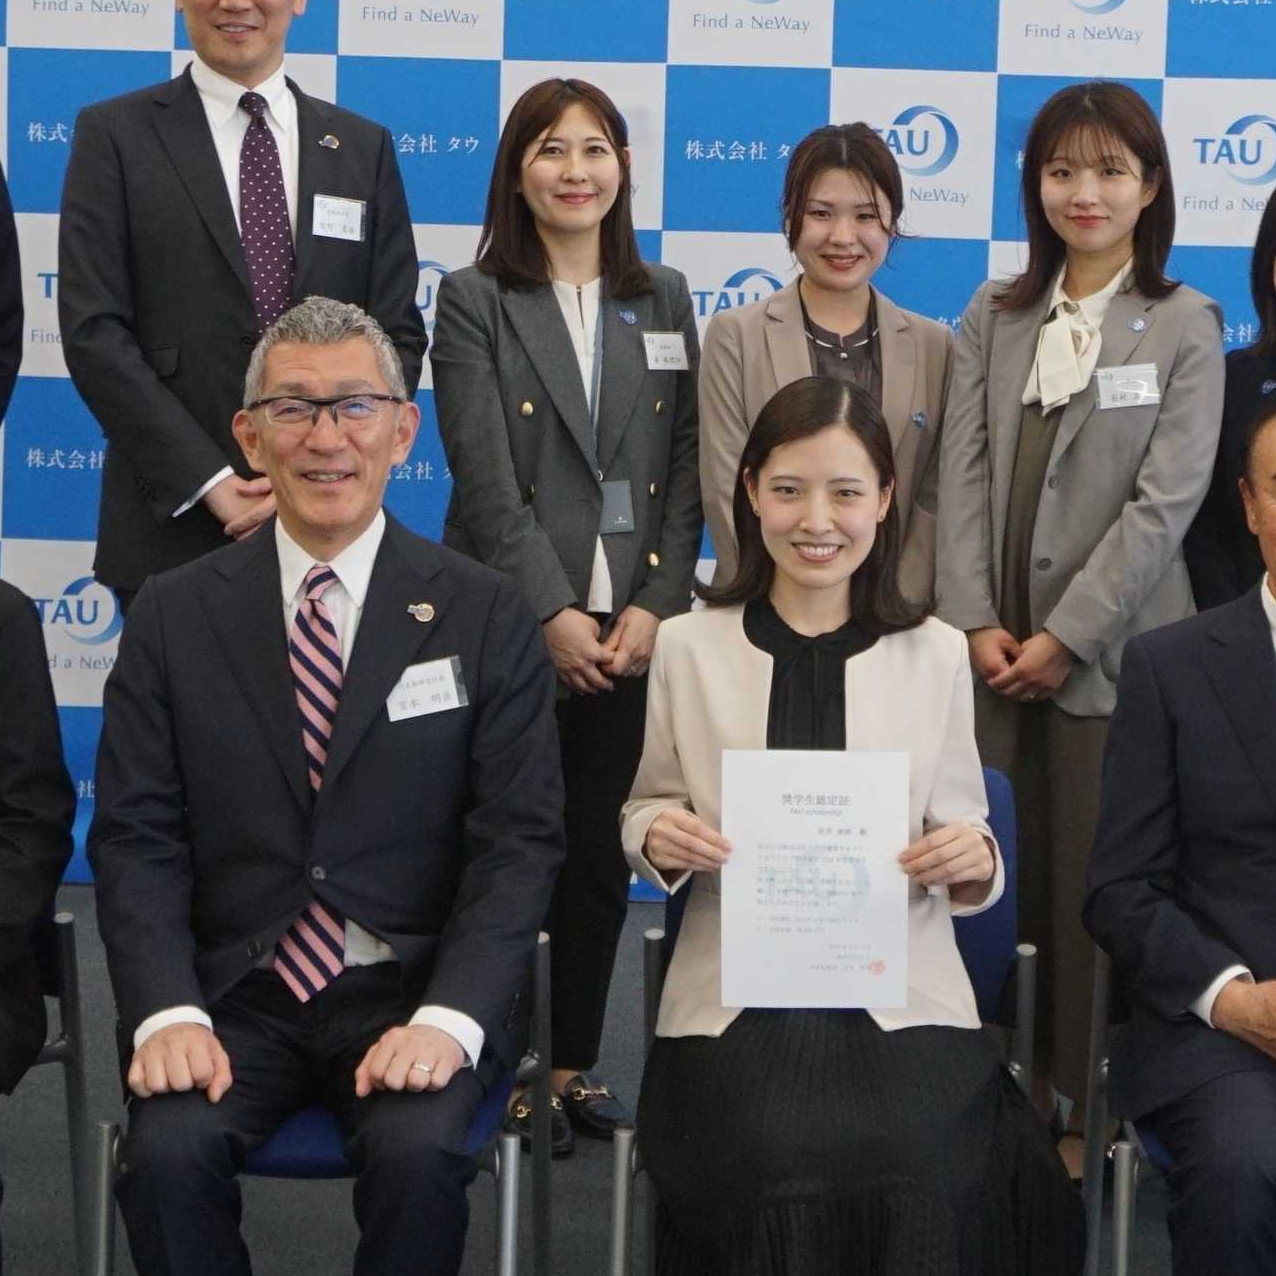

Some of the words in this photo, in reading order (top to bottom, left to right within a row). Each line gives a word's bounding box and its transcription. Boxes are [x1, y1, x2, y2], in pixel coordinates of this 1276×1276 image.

[74, 1, 84, 13] a
[362, 5, 398, 22] Find
[404, 11, 412, 22] a
[420, 8, 479, 28] NeWay
[692, 12, 728, 29] Find
[734, 18, 744, 29] a
[751, 15, 811, 35] NeWay
[1024, 23, 1061, 39] Find
[1066, 28, 1076, 40] a
[1083, 26, 1144, 45] NeWay
[27, 121, 75, 143] 株式
[396, 132, 438, 154] 会社
[445, 135, 480, 154] タウ
[874, 128, 930, 156] AU
[684, 139, 768, 161] 株式会社
[776, 143, 792, 160] タ
[1192, 138, 1262, 166] TAU
[909, 188, 970, 207] NeWay
[1183, 195, 1219, 211] Find
[1225, 200, 1234, 212] a
[1221, 322, 1257, 343] 会社
[26, 446, 106, 470] 株式会社
[393, 460, 435, 481] 会社
[30, 598, 99, 626] TAU
